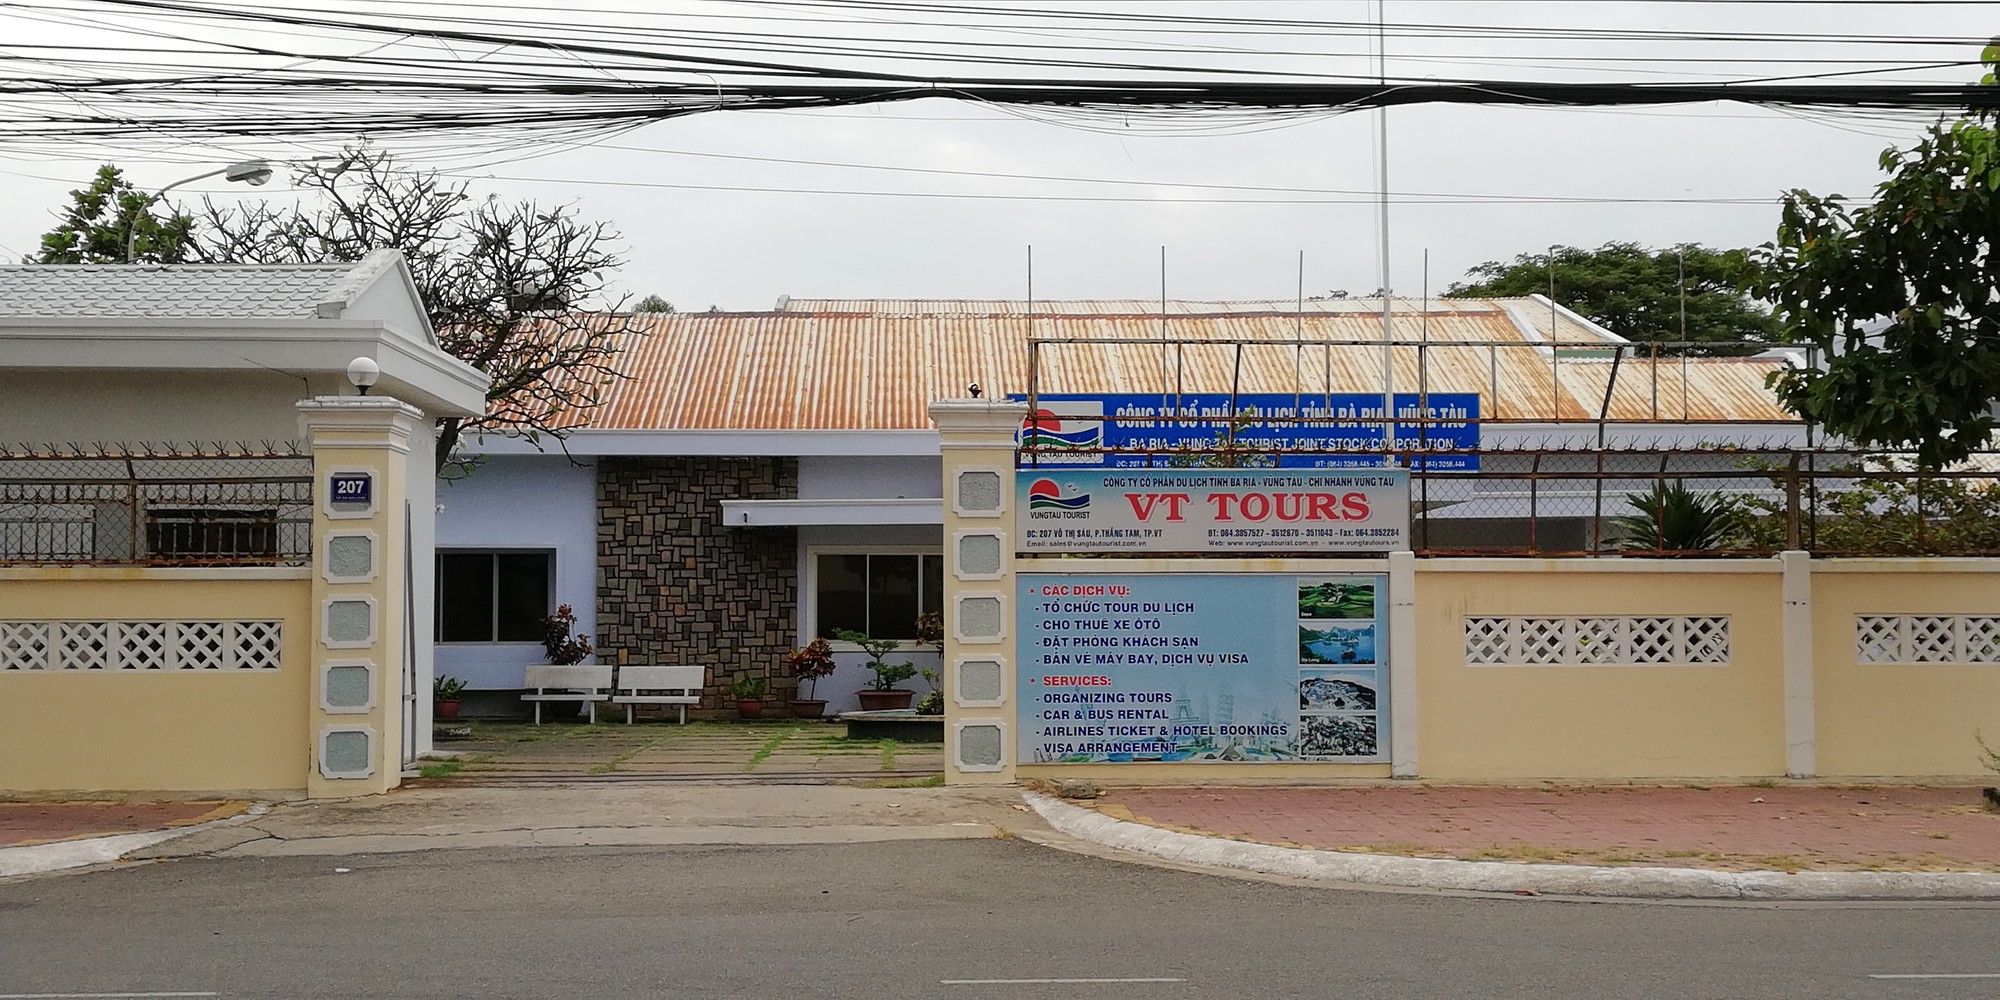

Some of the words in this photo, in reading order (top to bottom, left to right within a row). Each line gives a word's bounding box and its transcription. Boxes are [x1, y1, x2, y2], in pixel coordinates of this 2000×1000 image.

[1116, 402, 1154, 428] CÔNG
[1158, 407, 1174, 428] TY
[1179, 399, 1198, 428] CỔ
[1267, 407, 1298, 432] LỊCH
[1302, 400, 1334, 428] TỈNH
[1338, 402, 1357, 428] BÀ
[1361, 407, 1385, 432] RỊA
[1440, 402, 1466, 428] TÀU
[1130, 437, 1147, 450] BA
[1149, 437, 1169, 450] RIA
[1103, 476, 1125, 487] CÔNG
[1128, 478, 1137, 487] TY
[1140, 473, 1150, 487] CỔ
[1176, 478, 1187, 487] DU
[1189, 478, 1207, 489] LỊCH
[1243, 478, 1256, 489] RỊA
[1309, 477, 1322, 486] CHI
[338, 481, 364, 494] 207
[1124, 493, 1191, 521] VT
[1206, 493, 1370, 521] TOURS
[1030, 511, 1061, 519] VUNGTAU
[1063, 511, 1090, 519] TOURIST
[1040, 530, 1051, 538] 207
[1144, 529, 1162, 538] TP.VT
[1306, 529, 1333, 537] 3511043
[1340, 529, 1354, 537] Fax:
[1043, 583, 1069, 595] CÁC
[1073, 586, 1104, 598] DỊCH
[1109, 586, 1130, 598] VỤ:
[1043, 598, 1060, 613] TỔ
[1064, 600, 1100, 613] CHỨC
[1104, 603, 1139, 613] TOUR
[1143, 603, 1160, 613] DU
[1165, 603, 1194, 615] LỊCH
[1043, 620, 1070, 630] CHO
[1074, 618, 1109, 630] THUÊ
[1113, 620, 1130, 630] XE
[1135, 618, 1161, 630] ÔTÔ
[1043, 635, 1069, 650] ĐẶT
[1073, 634, 1118, 647] PHÒNG
[1123, 634, 1168, 647] KHÁCH
[1172, 637, 1198, 650] SẠN
[1044, 651, 1070, 664] BÁN
[1075, 651, 1091, 664] VÉ
[1096, 651, 1123, 664] MÁY
[1128, 654, 1158, 666] BAY,
[1162, 654, 1193, 667] DỊCH
[1197, 654, 1214, 667] VỤ
[1219, 654, 1249, 664] VISA
[1043, 676, 1111, 686] SERVICES:
[1043, 693, 1125, 703] ORGANIZING
[1129, 693, 1172, 703] TOURS
[1043, 710, 1070, 720] CAR
[1074, 710, 1083, 720] &
[1088, 710, 1114, 720] BUS
[1118, 709, 1169, 720] RENTAL
[1043, 726, 1104, 736] AIRLINES
[1108, 726, 1155, 736] TICKET
[1159, 726, 1169, 736] &
[1174, 726, 1216, 736] HOTEL
[1220, 725, 1288, 736] BOOKINGS
[1043, 743, 1074, 753] VISA
[1078, 742, 1178, 753] ARRANGEMENT
